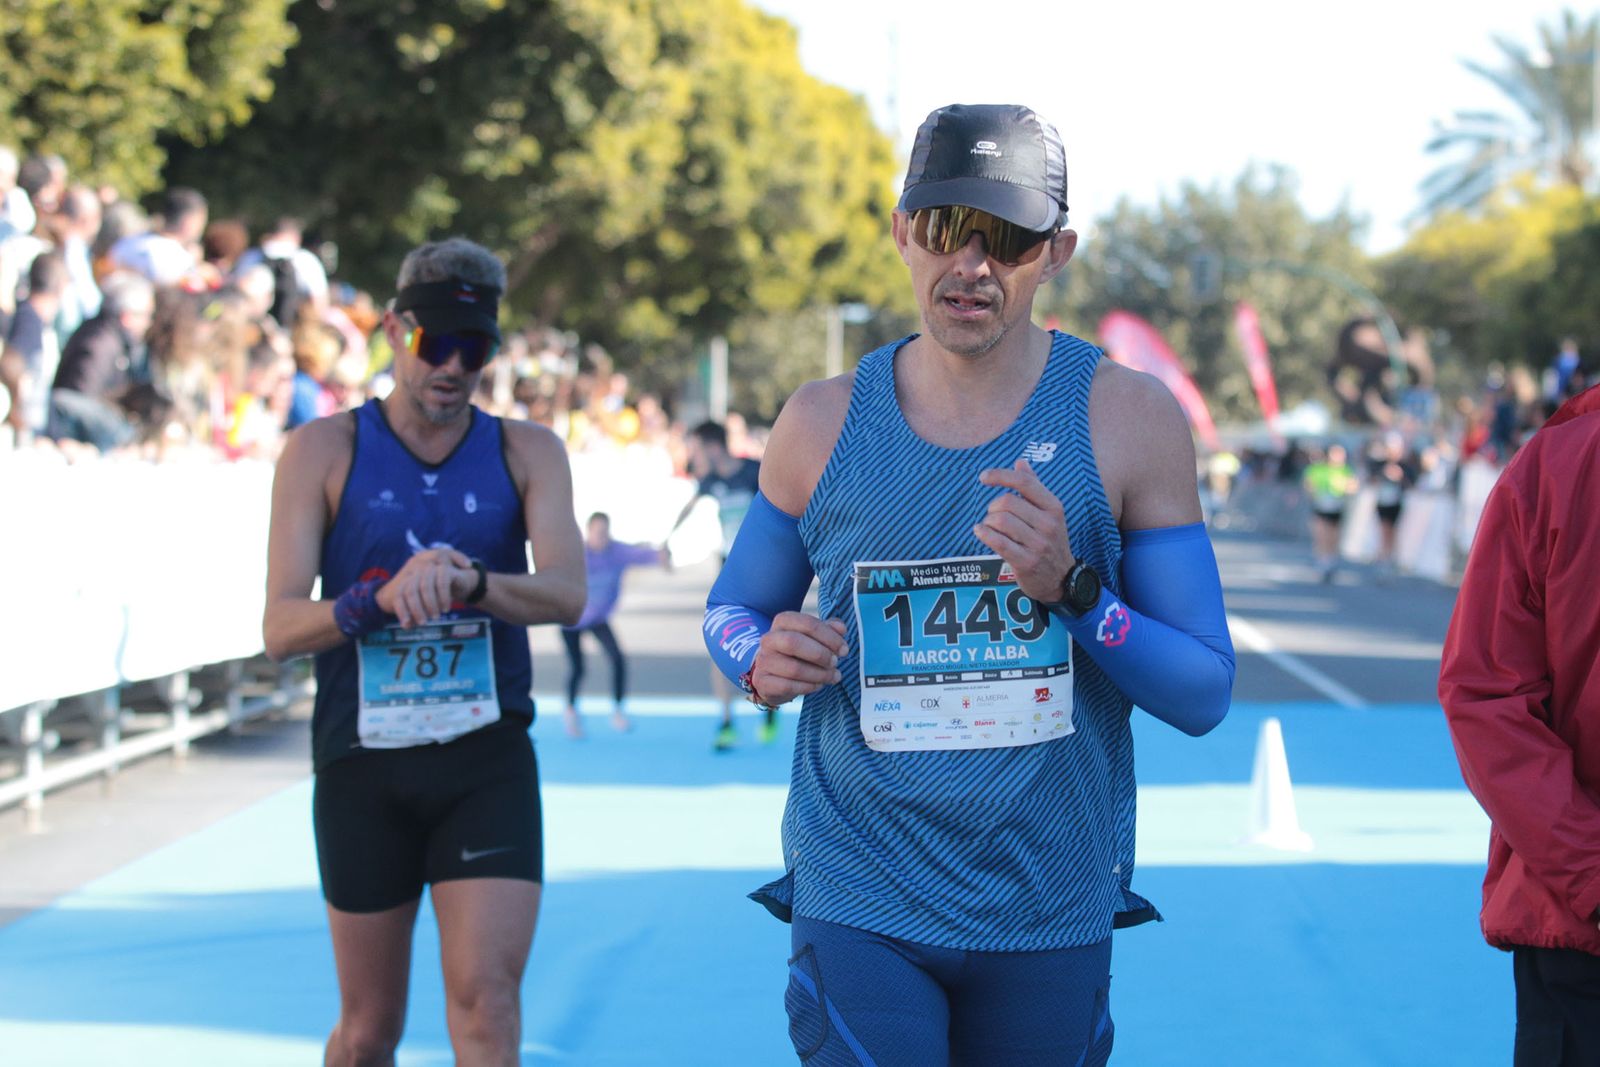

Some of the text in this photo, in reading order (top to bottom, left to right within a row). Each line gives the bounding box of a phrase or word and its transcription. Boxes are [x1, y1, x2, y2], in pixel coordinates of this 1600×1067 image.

[910, 564, 981, 577] Medio Maratón
[913, 574, 954, 586] Almería
[954, 572, 982, 583] 2022
[883, 588, 1047, 648] 1449
[388, 643, 464, 680] 787
[902, 645, 1030, 665] MARCO Y ALBA
